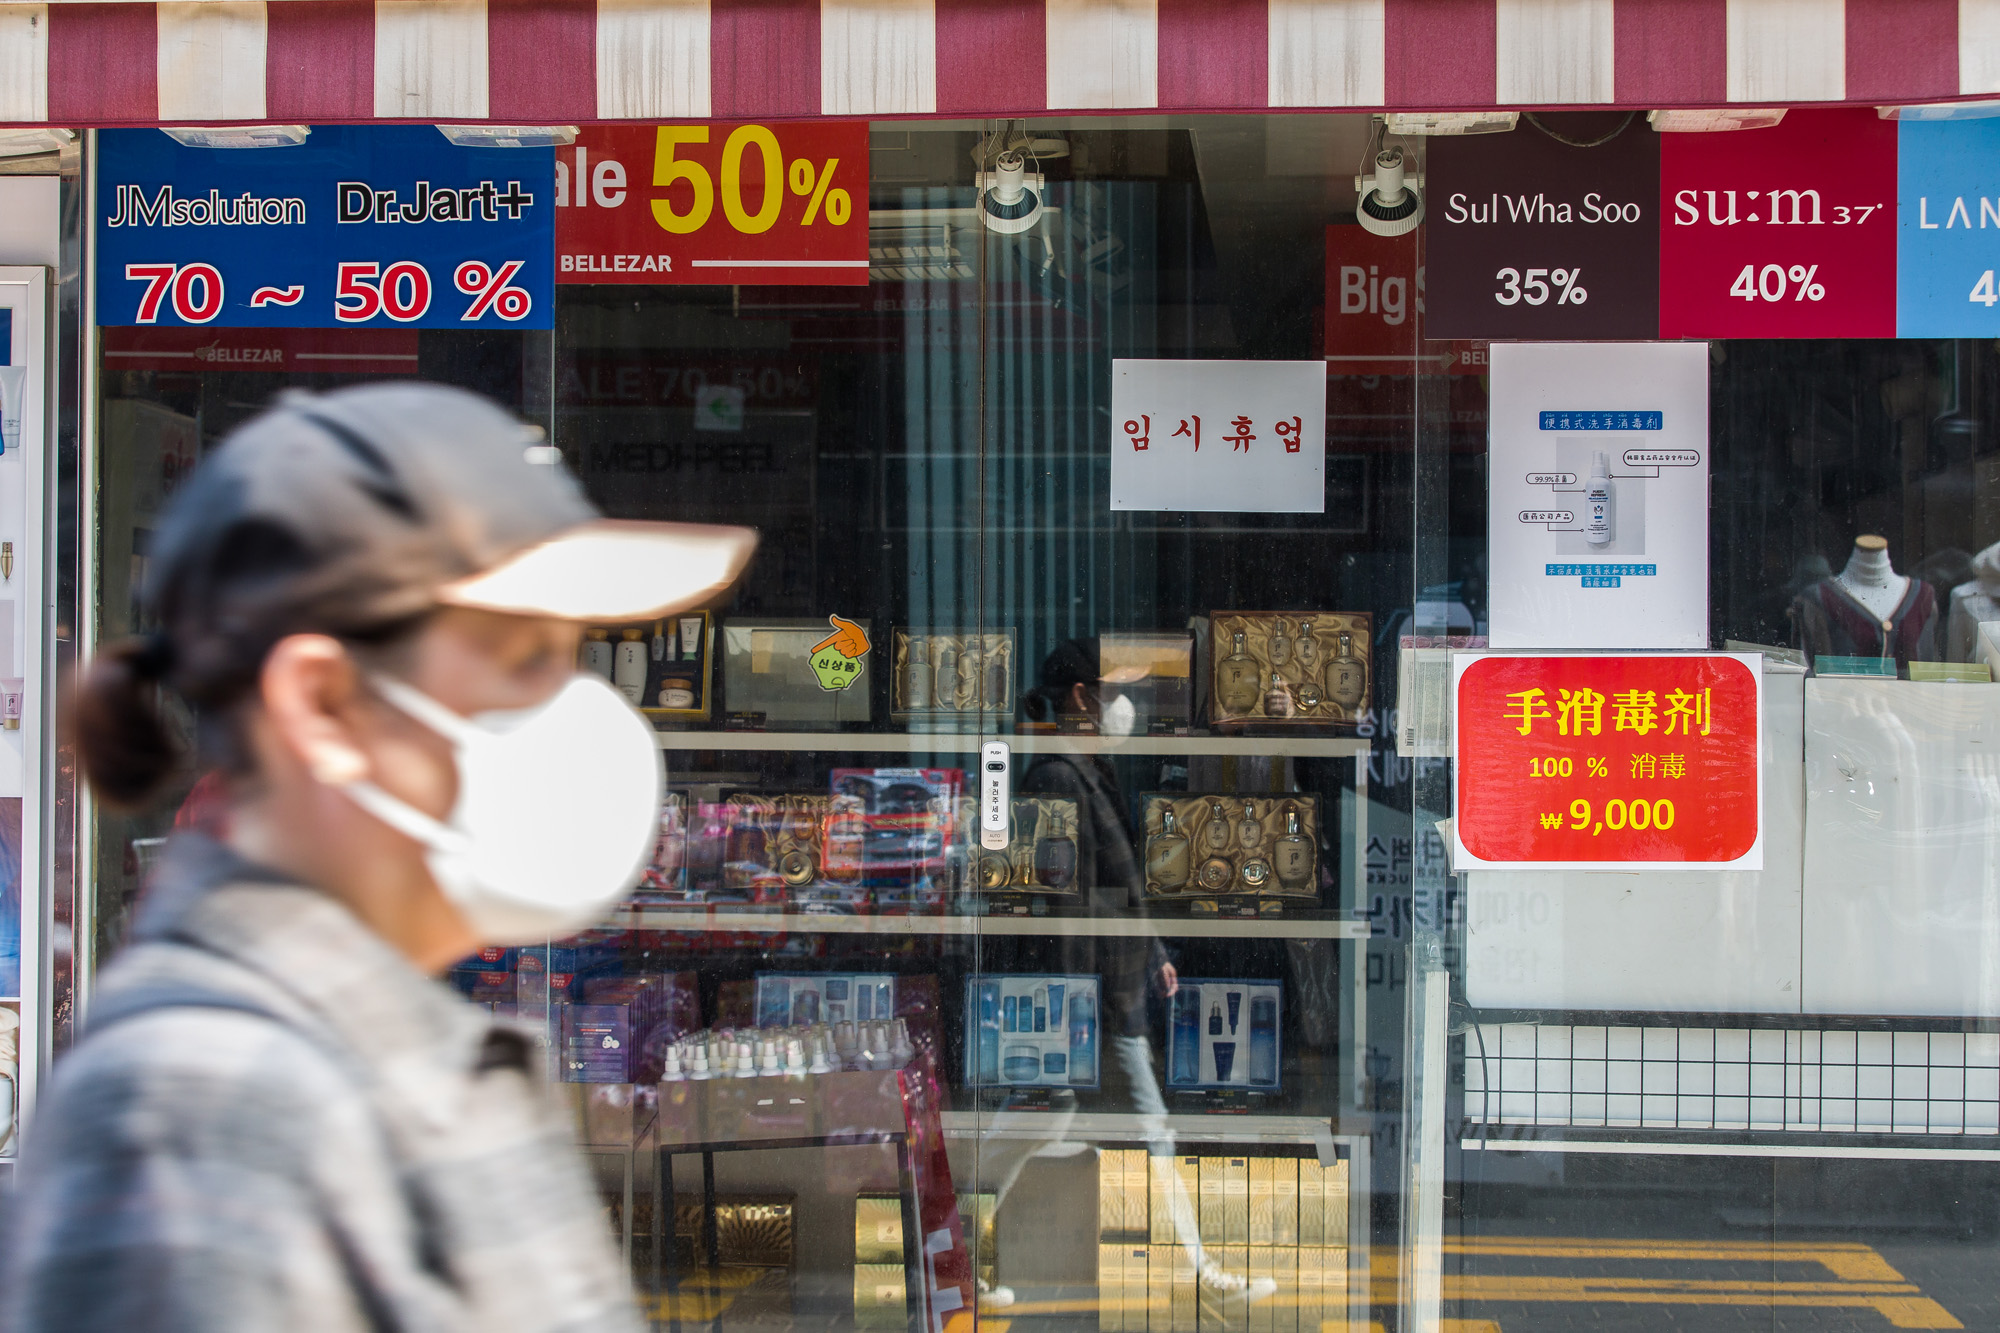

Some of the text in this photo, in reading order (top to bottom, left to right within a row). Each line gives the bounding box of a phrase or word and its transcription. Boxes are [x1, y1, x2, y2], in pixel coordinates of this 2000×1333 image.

[650, 125, 851, 235] 50%
[107, 184, 306, 227] JMsolution
[336, 181, 534, 224] Dr.Jart+
[560, 254, 673, 273] BELLEZAR
[1729, 263, 1826, 303] 40%
[125, 261, 225, 324] 70
[334, 260, 432, 322] 50
[453, 259, 532, 322] %
[1340, 265, 1407, 326] Big
[1494, 267, 1588, 306] 35%
[207, 348, 283, 363] BELLEZAR
[1544, 417, 1659, 430] 便携式洗手消毒剂
[1522, 512, 1571, 521] 医药公司产品
[818, 658, 857, 674] 신상품
[1502, 687, 1712, 738] 手消毒剂
[1529, 752, 1687, 780] 100 % 消毒
[991, 779, 999, 822] 눌러주세요
